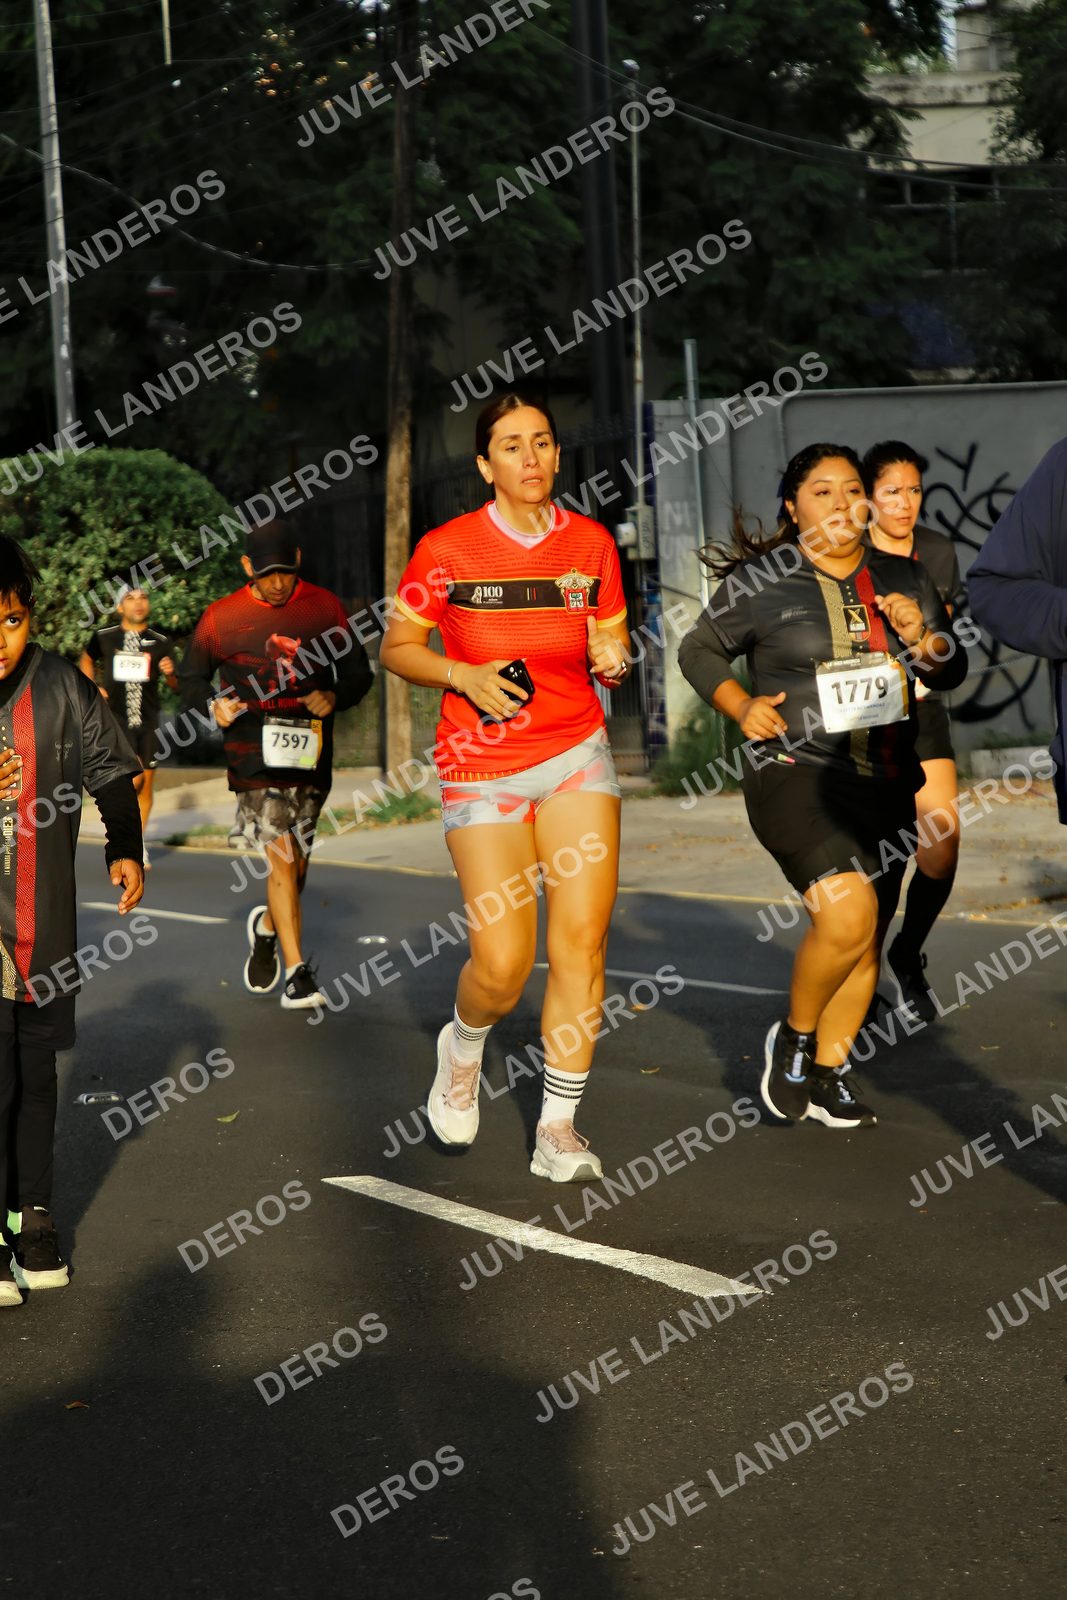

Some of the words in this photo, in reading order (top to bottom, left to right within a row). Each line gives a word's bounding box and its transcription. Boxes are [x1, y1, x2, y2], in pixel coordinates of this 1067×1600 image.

[482, 586, 503, 598] 100
[831, 676, 889, 705] 1779
[271, 732, 309, 750] 7597
